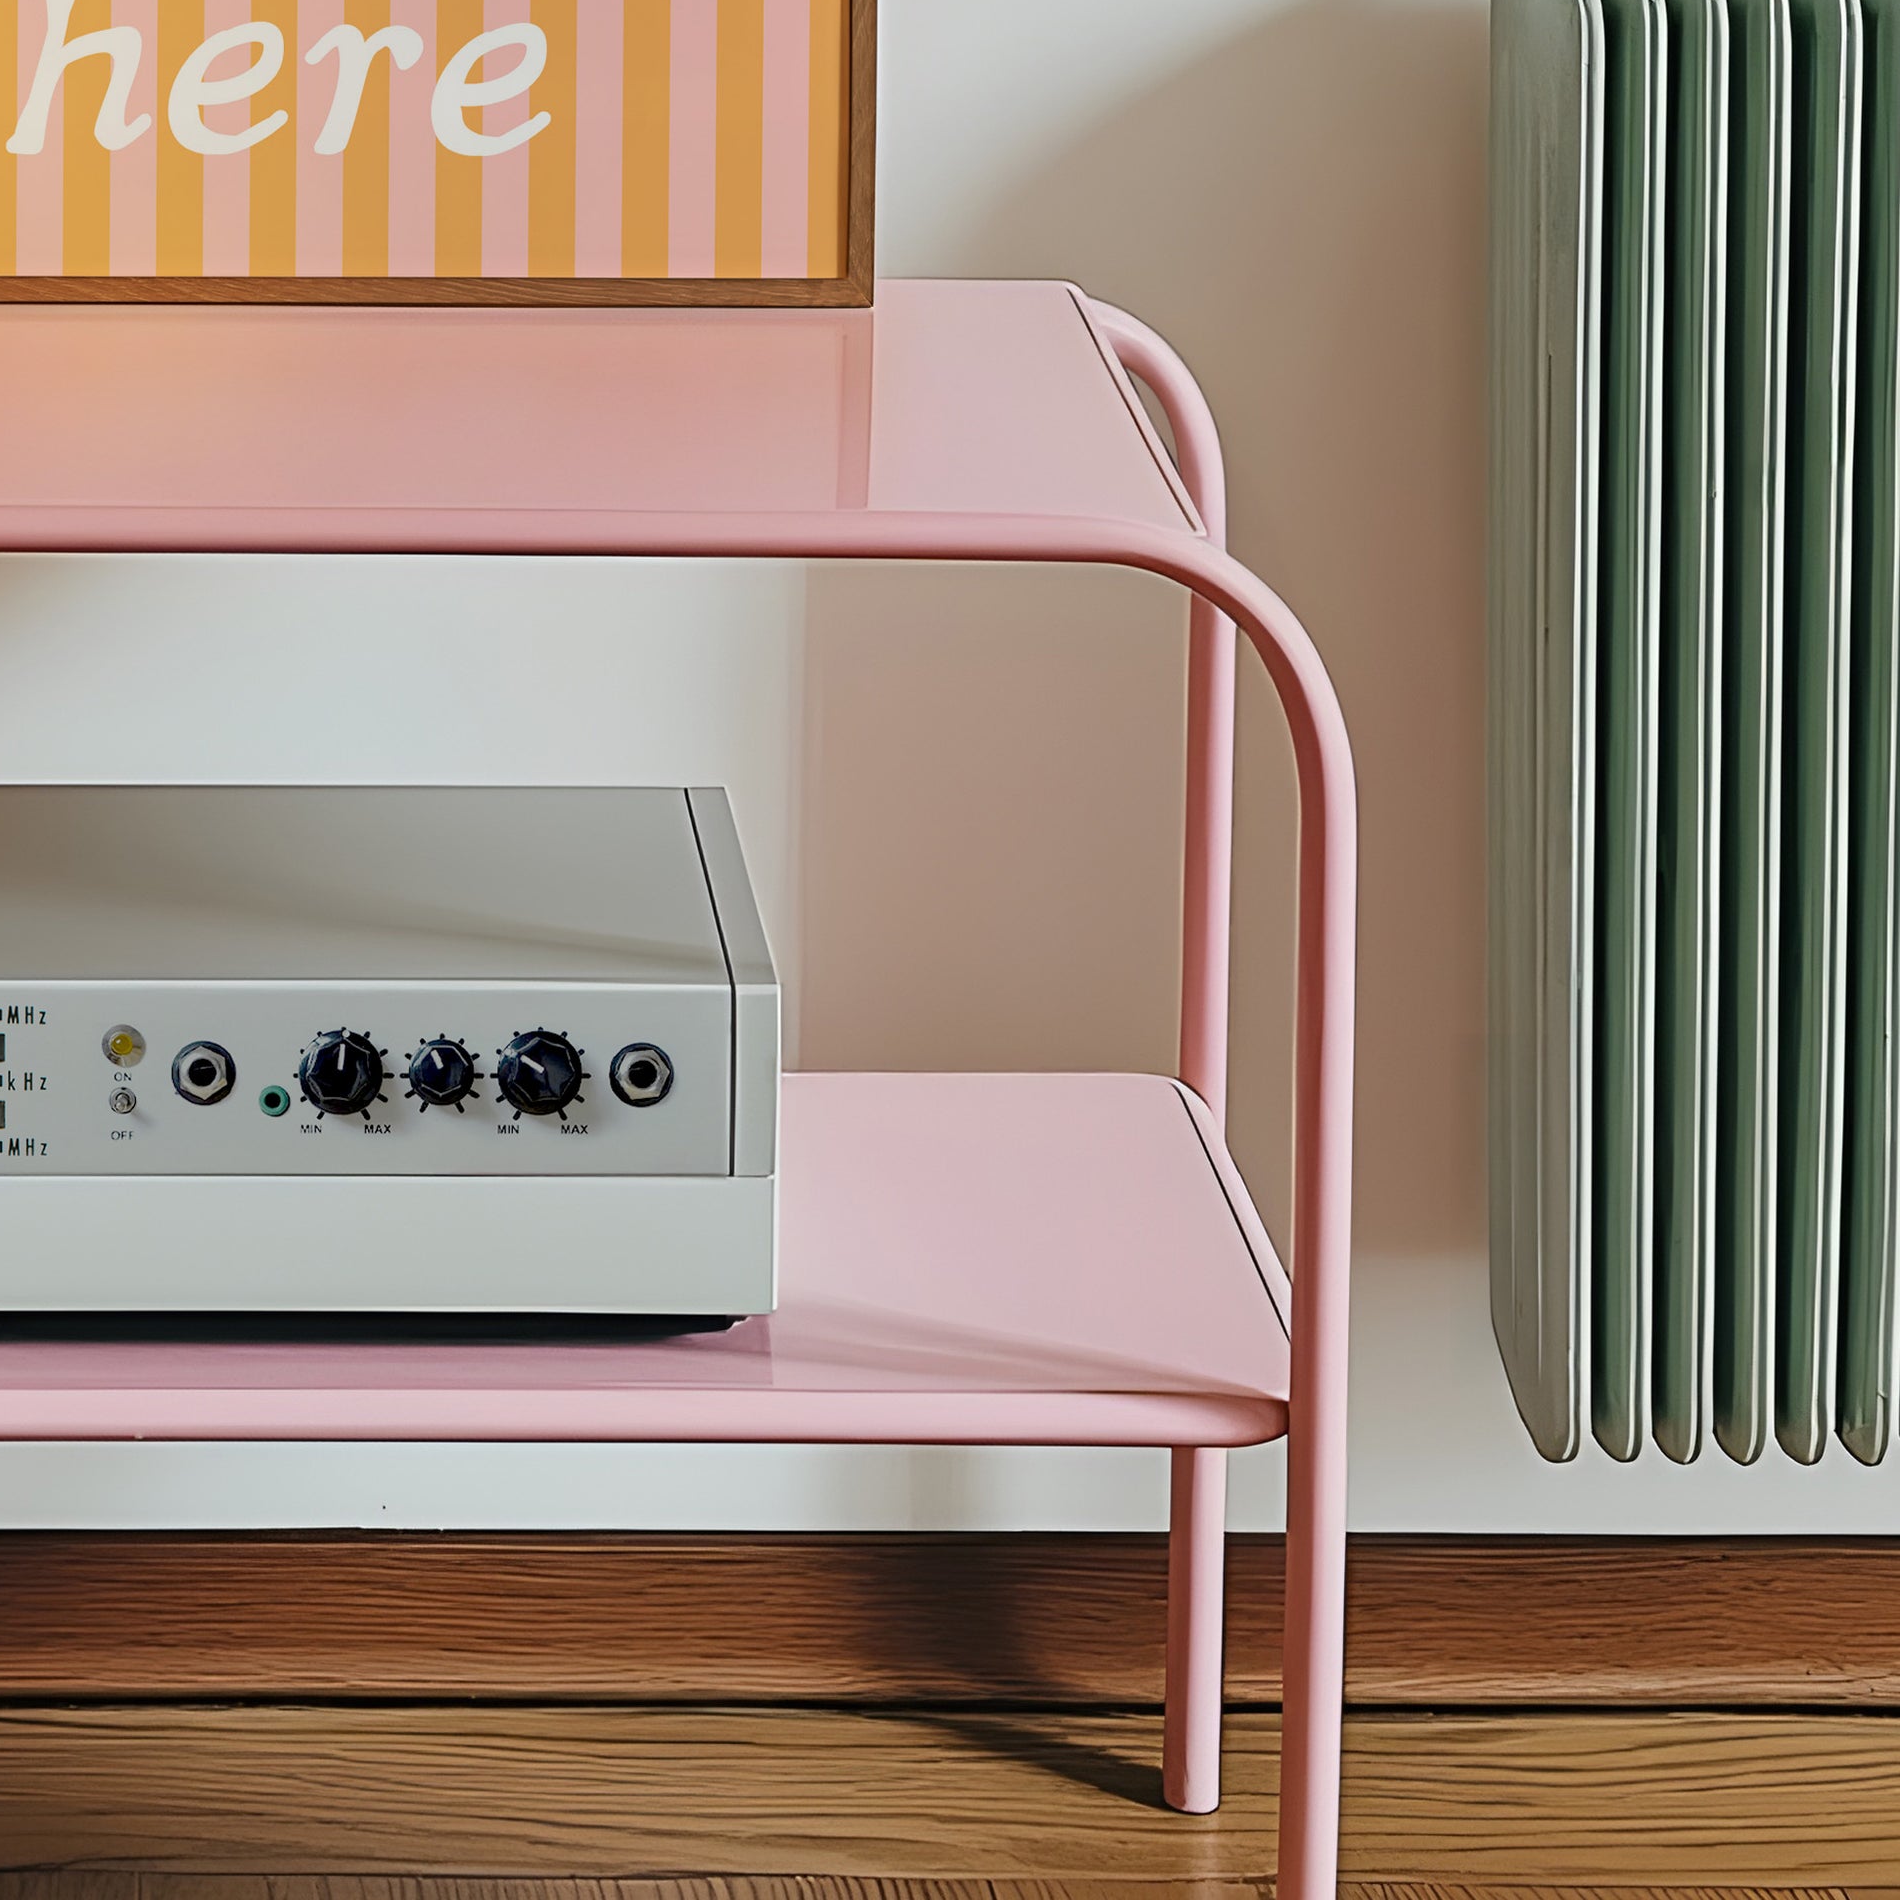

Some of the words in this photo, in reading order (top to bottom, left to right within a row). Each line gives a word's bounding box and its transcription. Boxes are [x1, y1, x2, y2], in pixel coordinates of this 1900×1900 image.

[7, 1006, 47, 1025] MHz
[113, 1071, 133, 1082] ON
[300, 1124, 322, 1135] MIN
[363, 1124, 391, 1135] MAX
[497, 1124, 520, 1135] MIN
[560, 1124, 588, 1135] MAX
[110, 1130, 135, 1141] OFF
[8, 1138, 47, 1157] MHz
